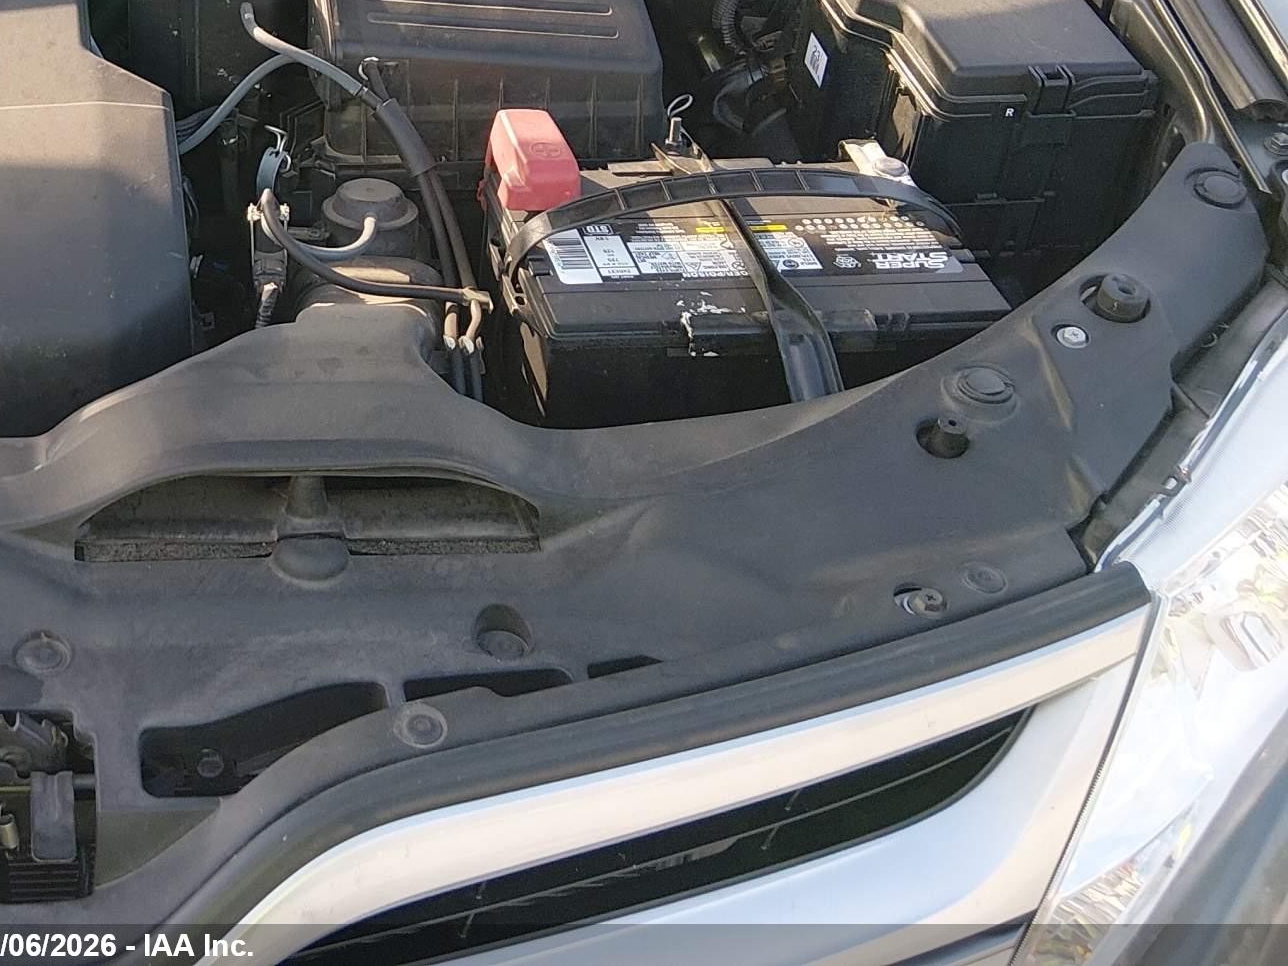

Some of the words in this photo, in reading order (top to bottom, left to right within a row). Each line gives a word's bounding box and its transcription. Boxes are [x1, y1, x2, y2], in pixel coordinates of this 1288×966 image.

[1005, 107, 1015, 117] R
[875, 251, 948, 261] START
[875, 261, 945, 269] SUPER
